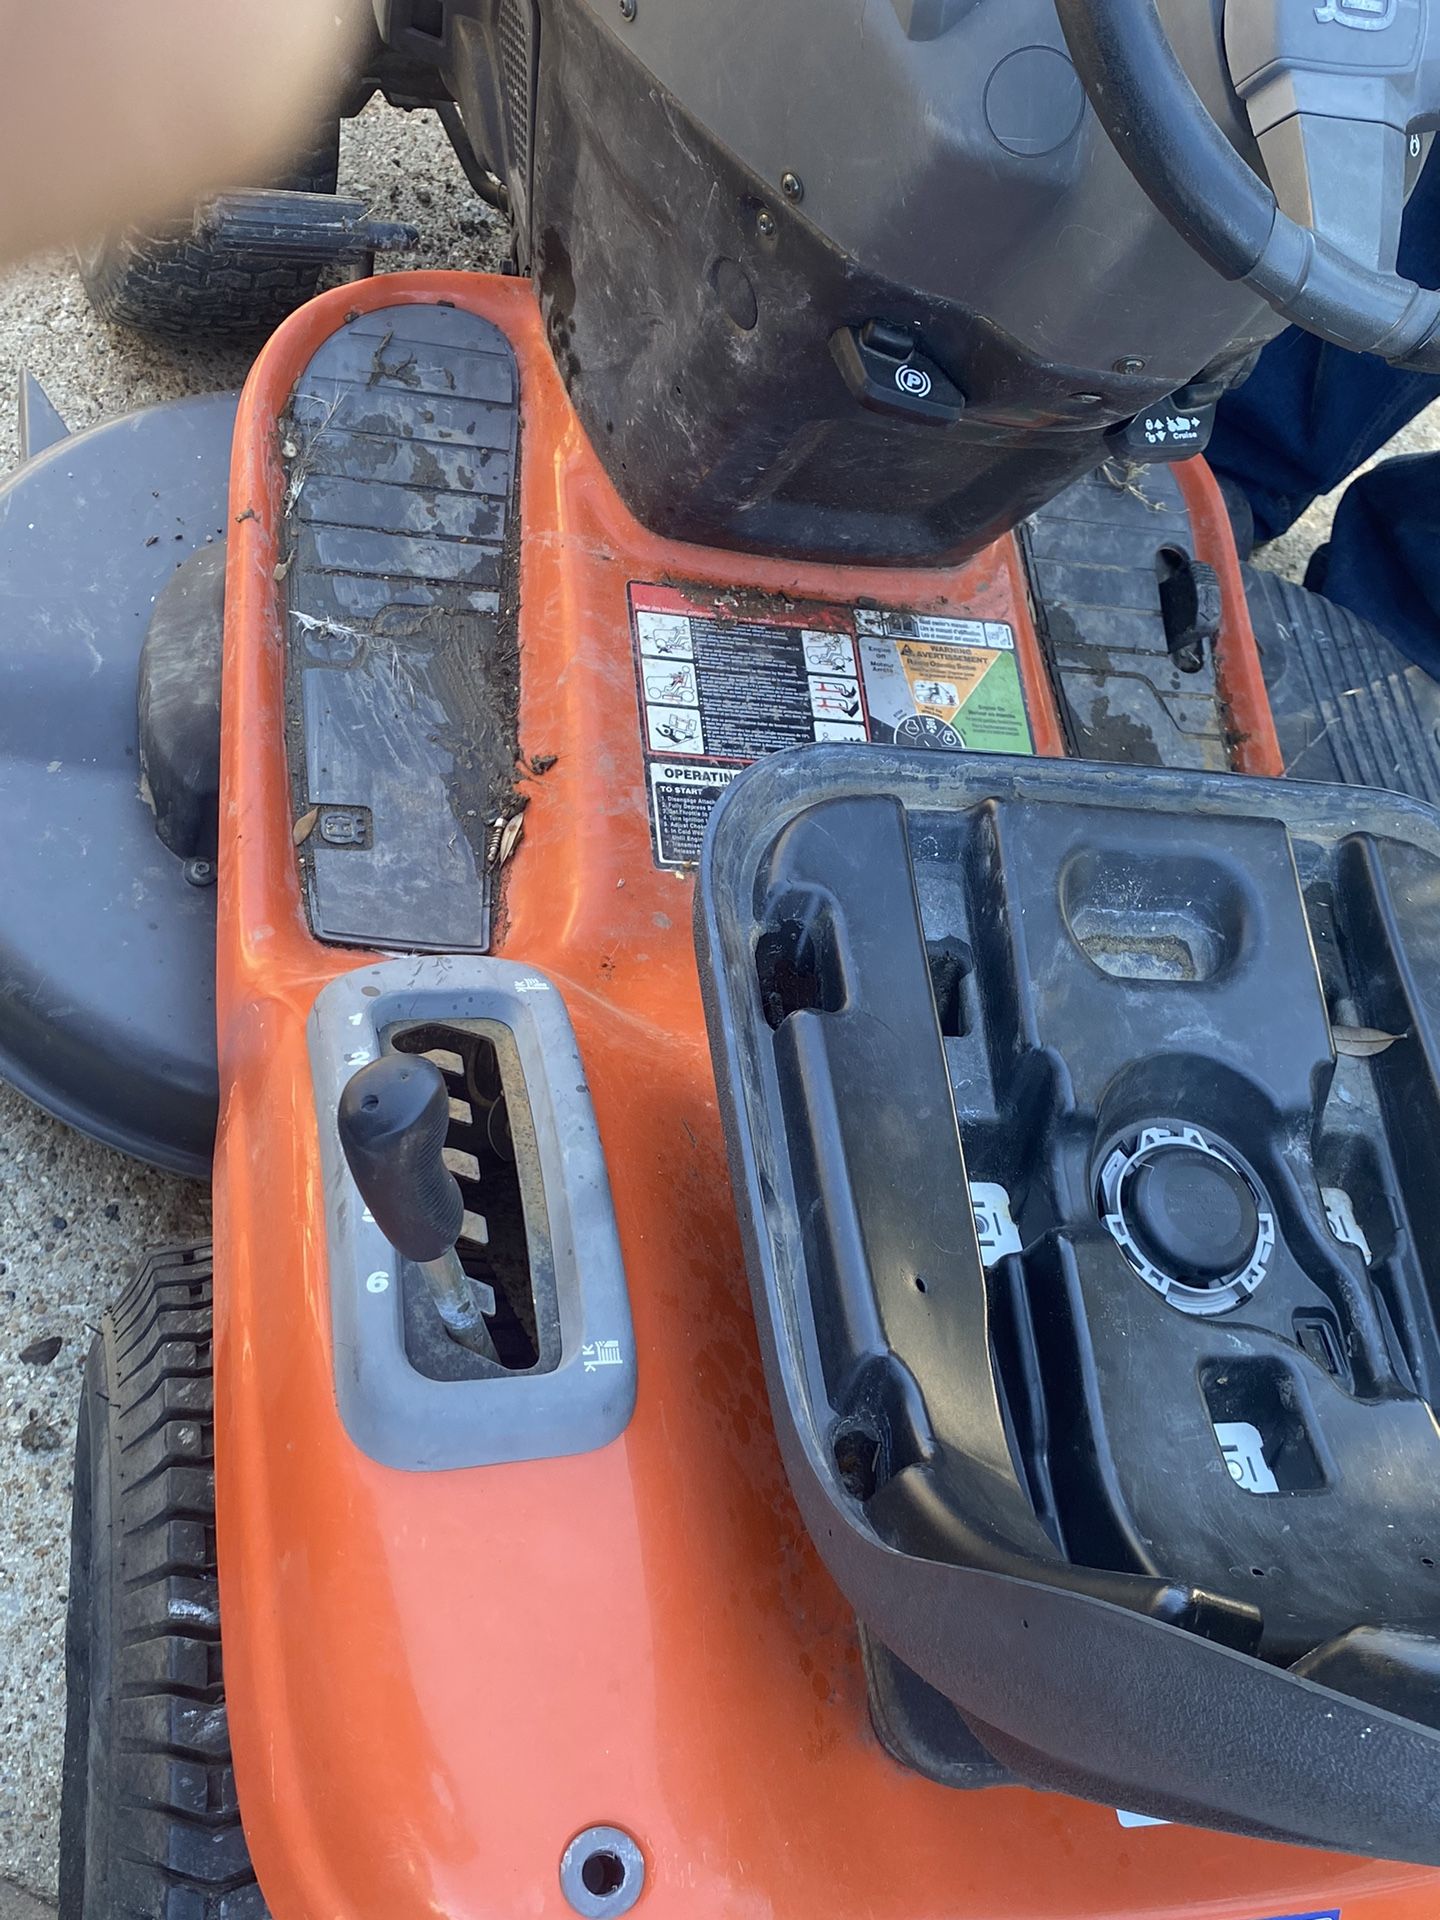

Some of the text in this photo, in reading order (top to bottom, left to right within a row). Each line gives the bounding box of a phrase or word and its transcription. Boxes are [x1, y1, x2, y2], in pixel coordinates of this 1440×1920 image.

[906, 373, 922, 387] P
[1173, 431, 1197, 439] Cruise
[930, 645, 972, 655] WARNING
[916, 651, 988, 664] AVERTISSEMENT
[674, 786, 703, 795] START
[668, 796, 697, 804] Disengage
[683, 803, 706, 811] Depress
[671, 821, 689, 829] Adjust
[348, 1012, 363, 1026] 1
[348, 1051, 371, 1066] 2
[366, 1270, 390, 1294] 6
